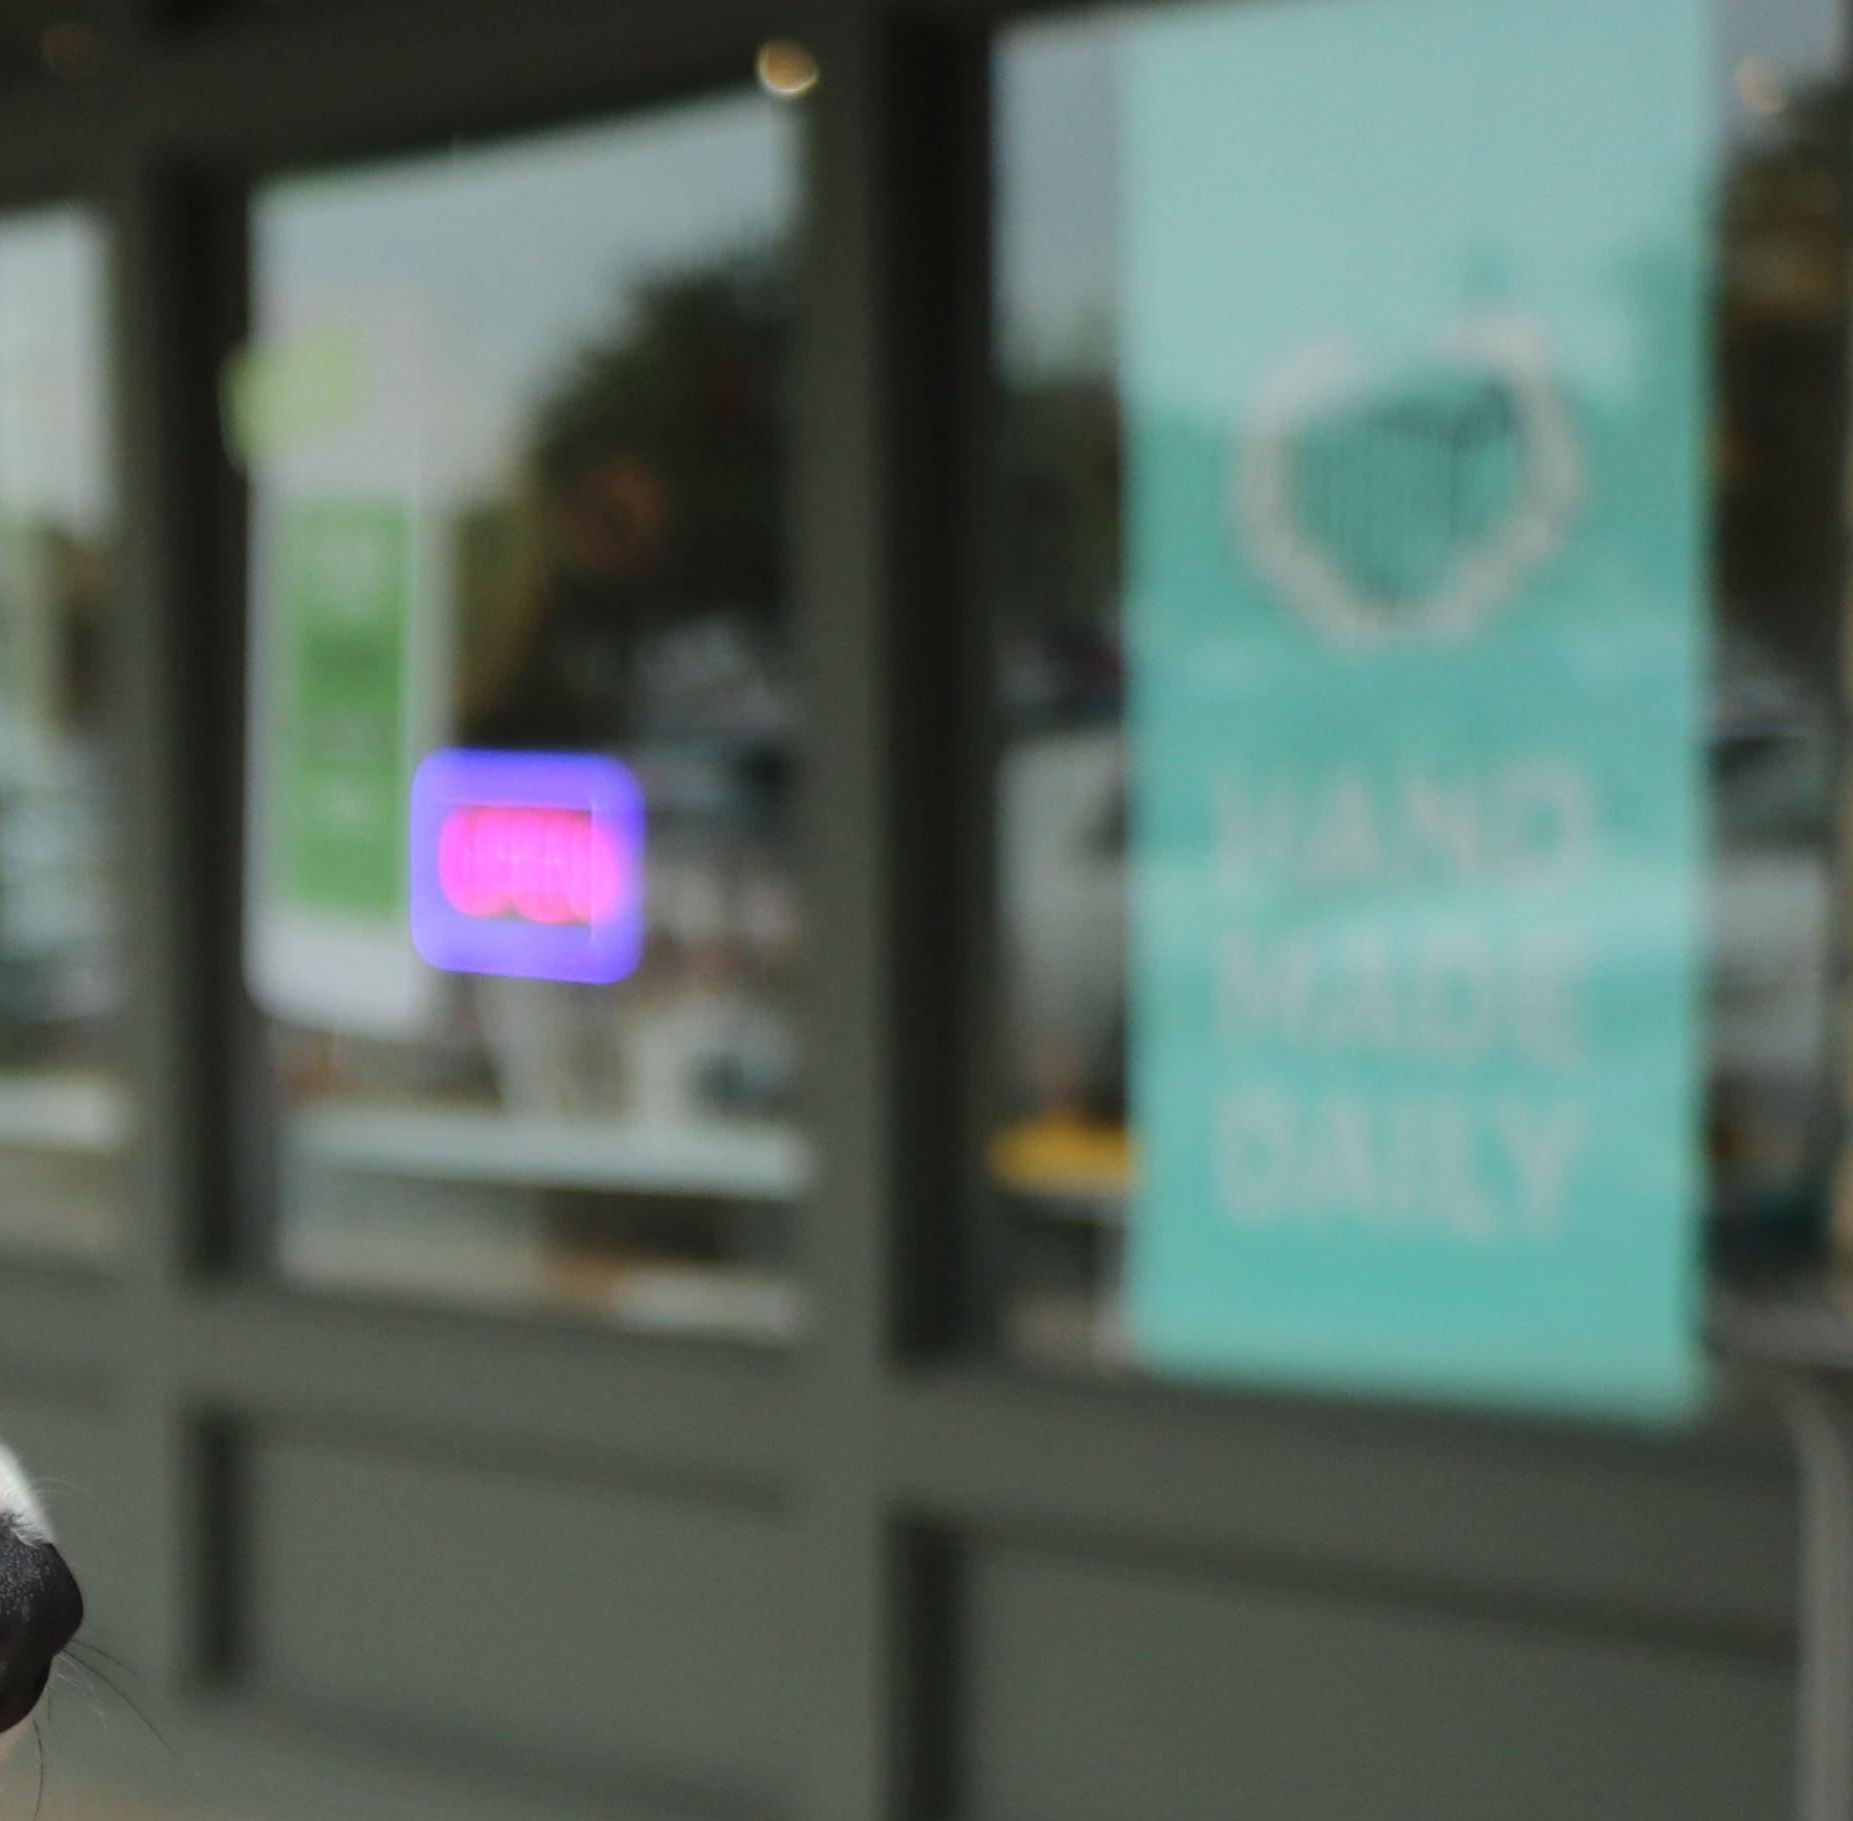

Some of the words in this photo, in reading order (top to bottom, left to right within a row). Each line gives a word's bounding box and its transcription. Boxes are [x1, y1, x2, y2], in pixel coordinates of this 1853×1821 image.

[1211, 758, 1588, 890] HAND
[1214, 922, 1584, 1062] MADE
[1214, 1088, 1584, 1245] DAILY
